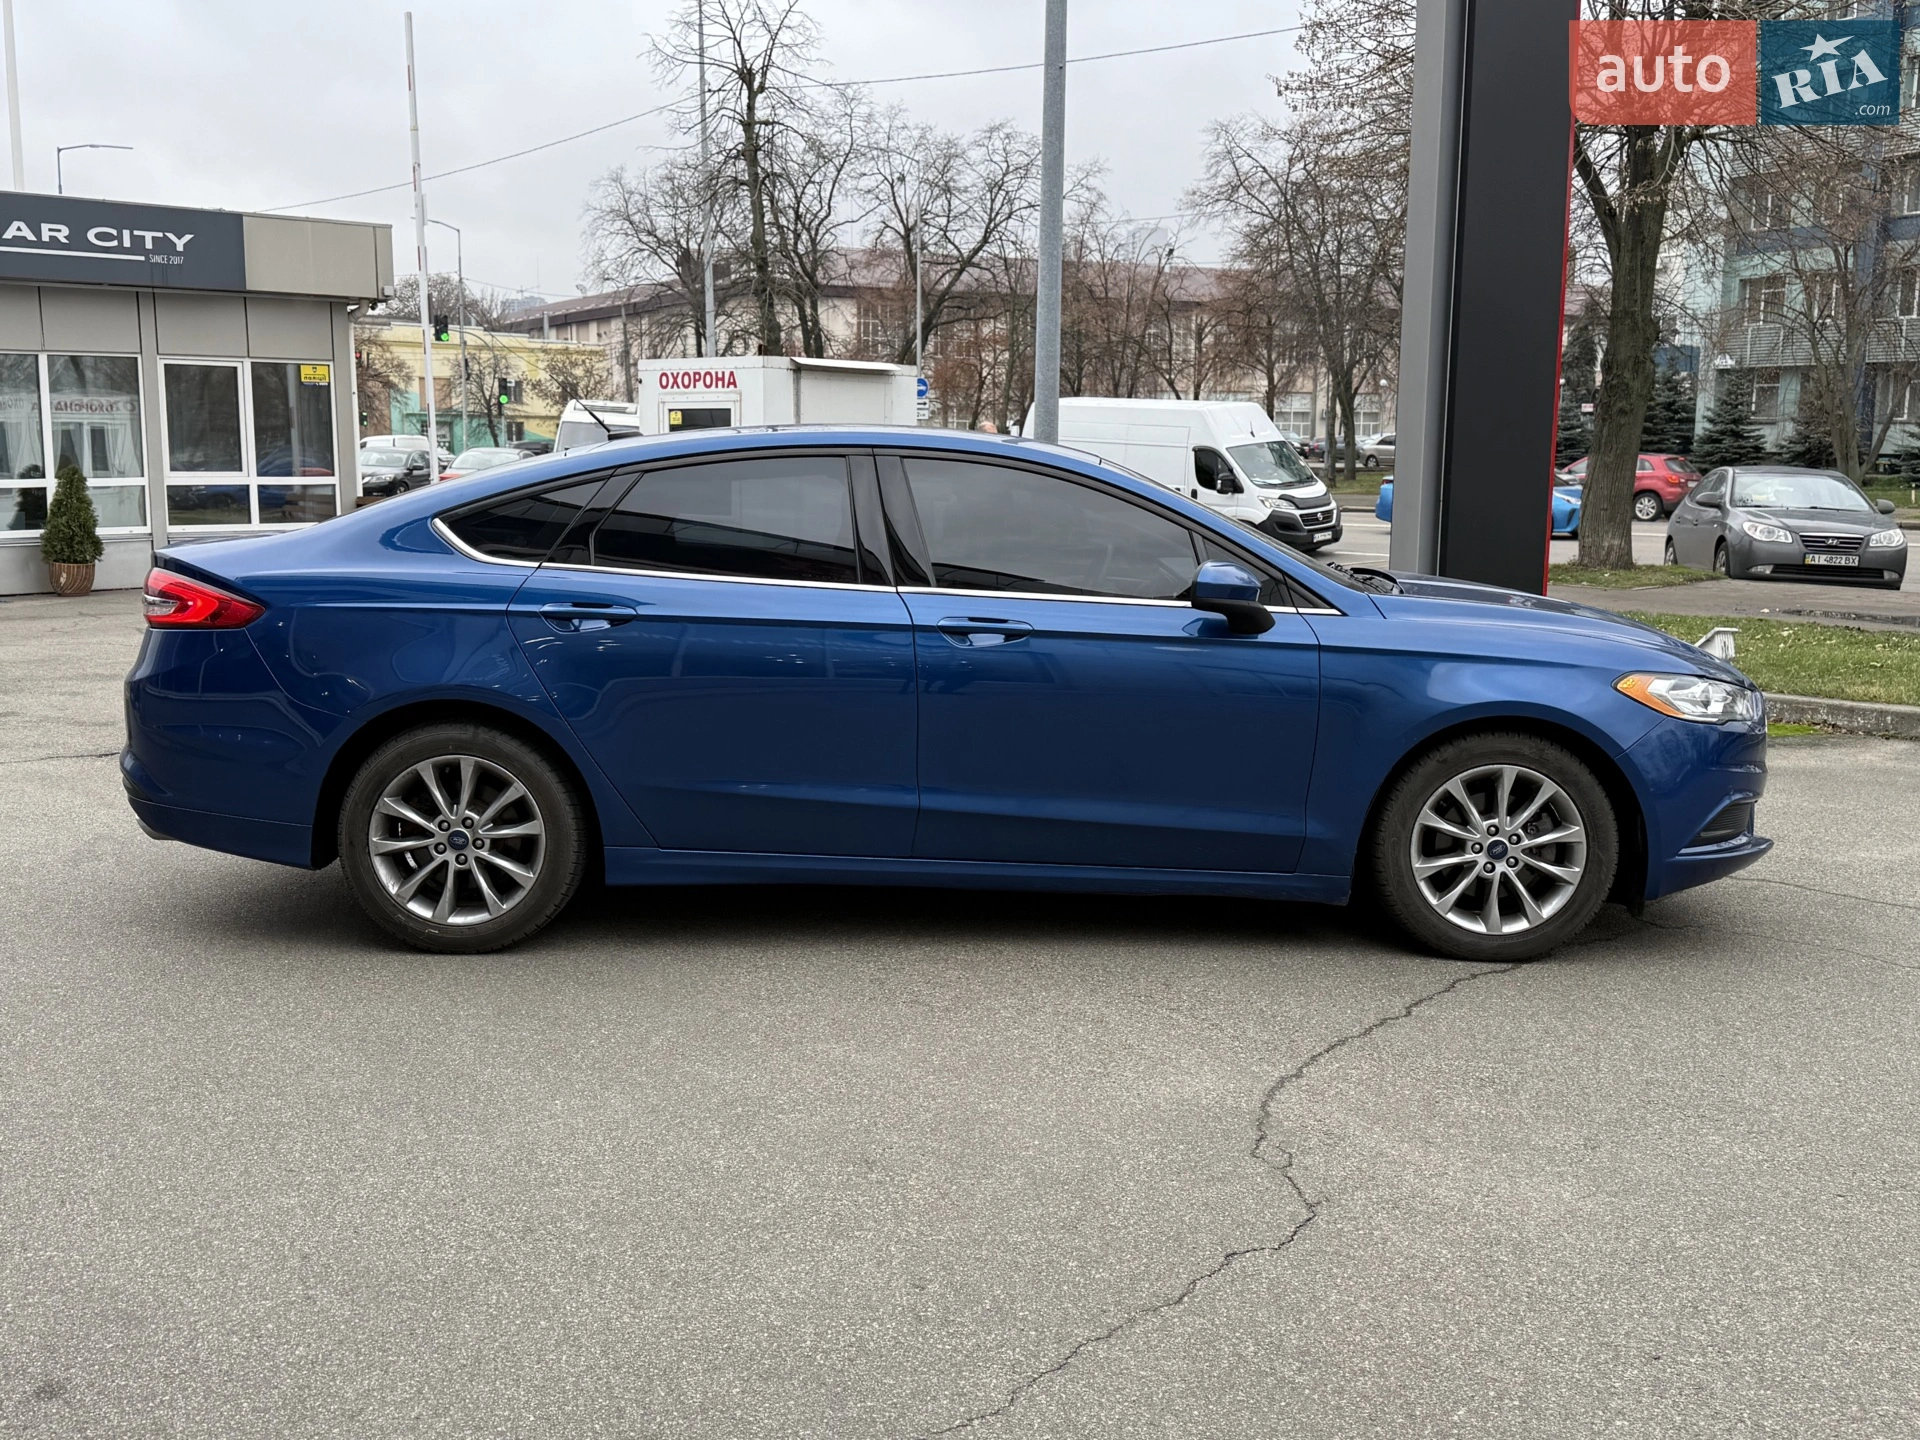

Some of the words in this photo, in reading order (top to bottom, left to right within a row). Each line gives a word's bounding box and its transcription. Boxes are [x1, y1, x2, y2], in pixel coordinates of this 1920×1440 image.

[1, 220, 70, 244] AR
[86, 226, 195, 252] CITY
[149, 253, 168, 265] SINCE
[169, 255, 184, 265] 2017
[658, 370, 738, 390] ОХОРОНА
[1810, 555, 1821, 564] AI
[1823, 556, 1844, 565] 4822
[1844, 556, 1857, 565] BX
